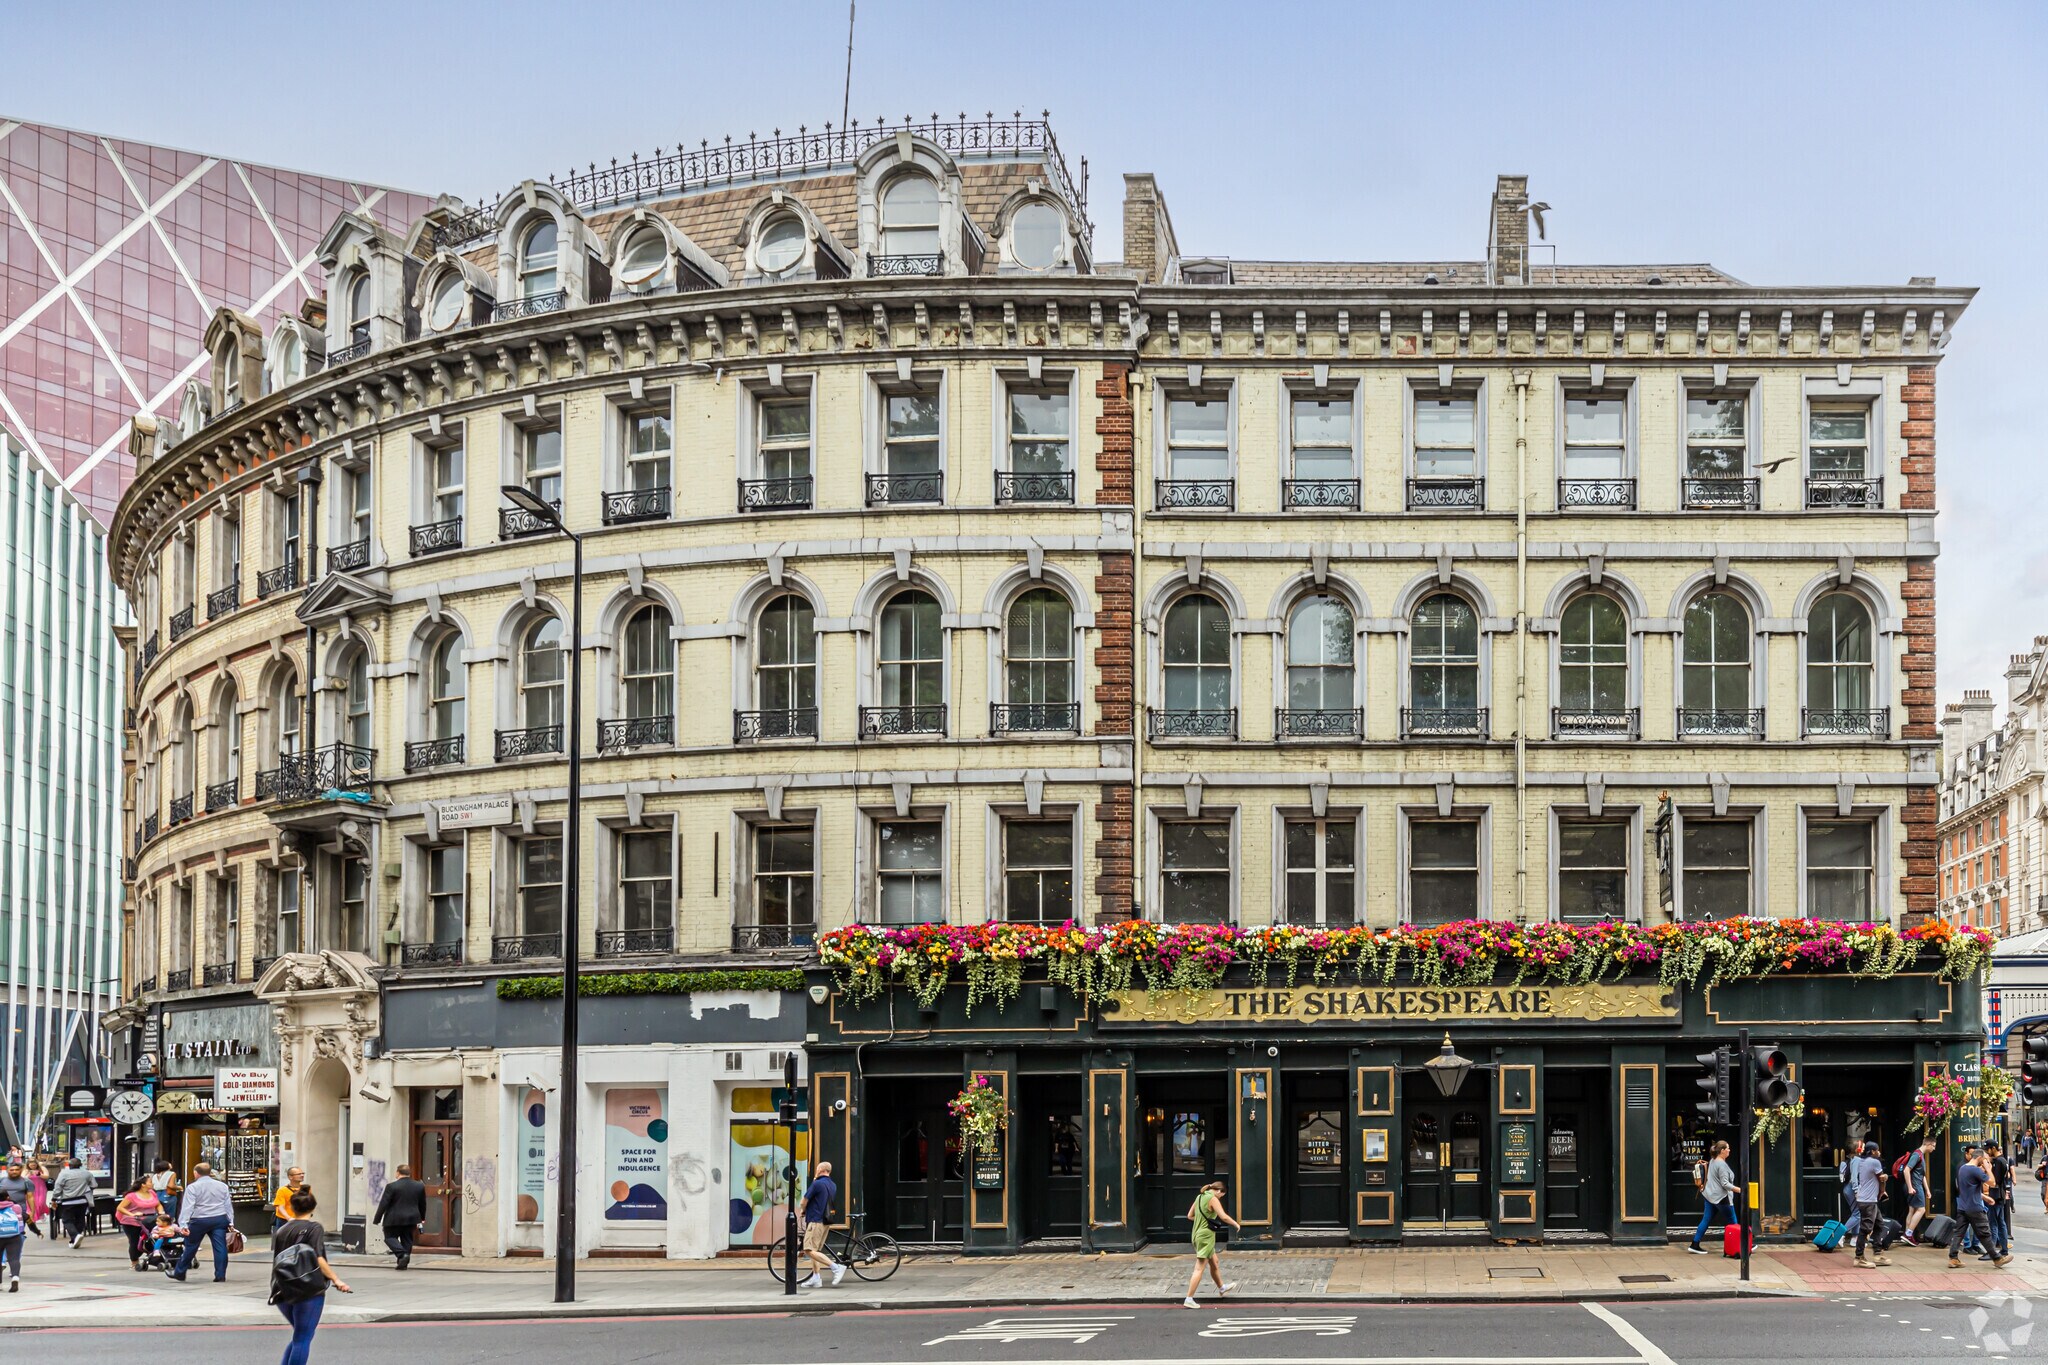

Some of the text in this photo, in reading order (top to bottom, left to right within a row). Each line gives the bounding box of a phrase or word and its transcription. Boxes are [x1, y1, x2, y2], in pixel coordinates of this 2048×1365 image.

[441, 800, 509, 813] BUCKINGHAM PALACE
[441, 813, 459, 821] ROAD
[1224, 989, 1553, 1015] THE SHAKESPEARE
[185, 1039, 233, 1059] STAIN
[235, 1045, 251, 1055] LTD
[222, 1081, 239, 1089] GOLD
[231, 1094, 268, 1102] JEWELLERY
[1551, 1136, 1573, 1144] BEER
[1551, 1145, 1573, 1156] Wine
